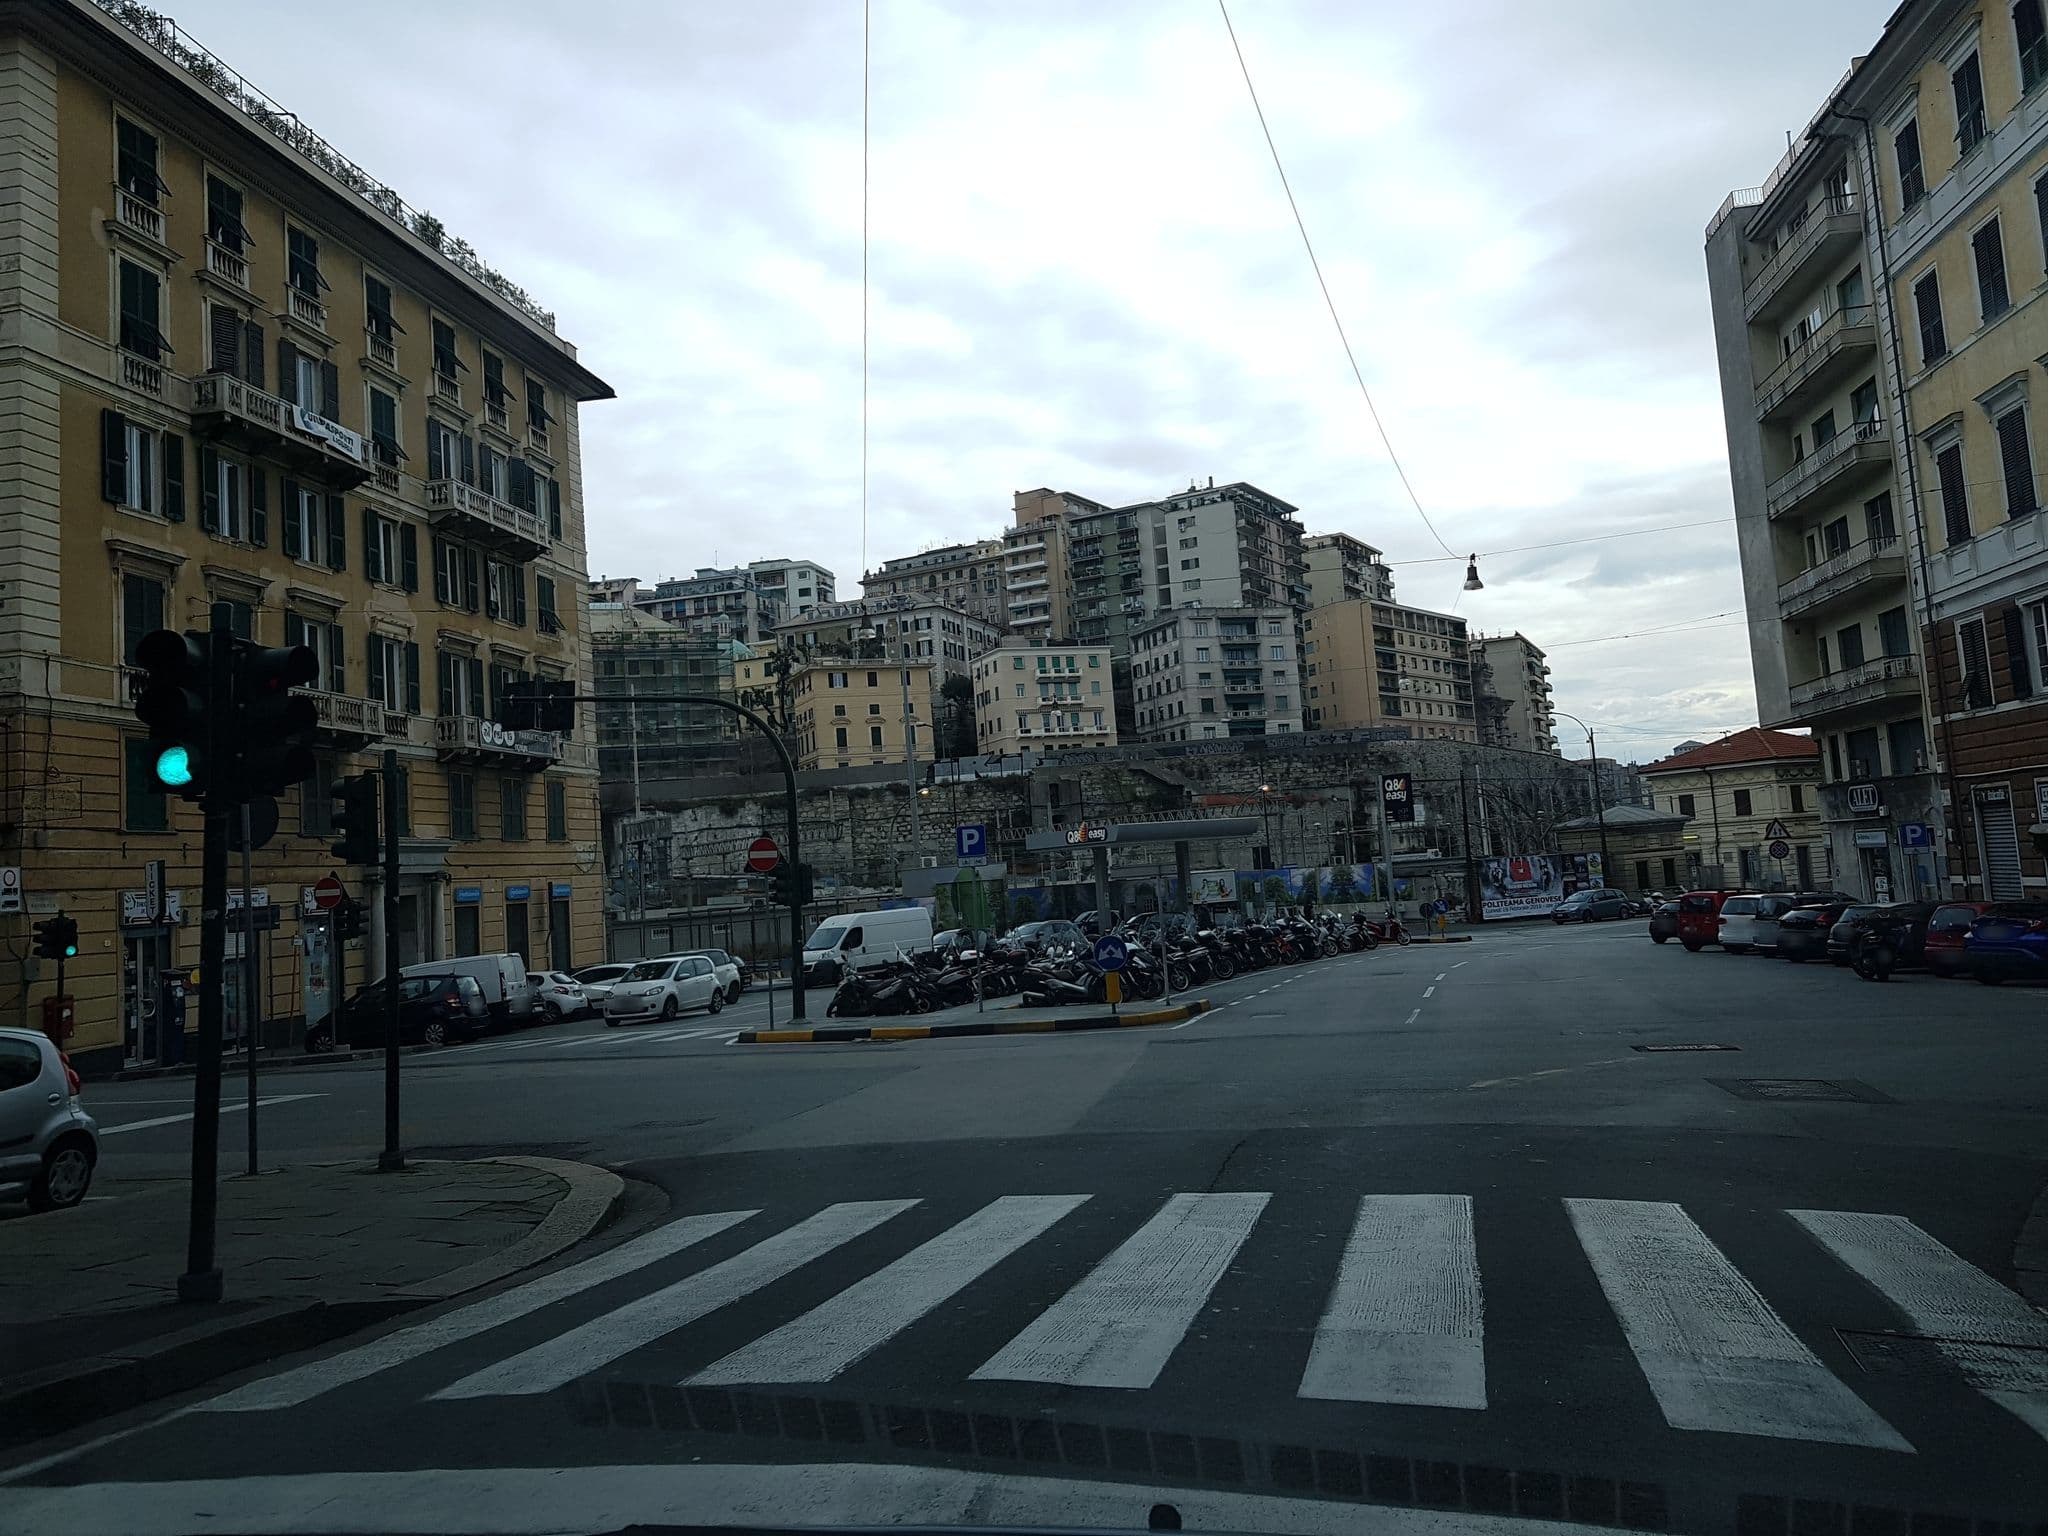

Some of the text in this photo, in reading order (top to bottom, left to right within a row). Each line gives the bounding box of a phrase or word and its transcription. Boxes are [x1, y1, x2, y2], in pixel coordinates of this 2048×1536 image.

[1384, 778, 1399, 792] Q8
[1385, 790, 1407, 802] easy
[962, 829, 979, 854] P
[1067, 828, 1106, 844] Q8 easy
[1905, 825, 1921, 844] P
[148, 864, 156, 914] TICKET
[1483, 898, 1524, 908] POLITEAMA
